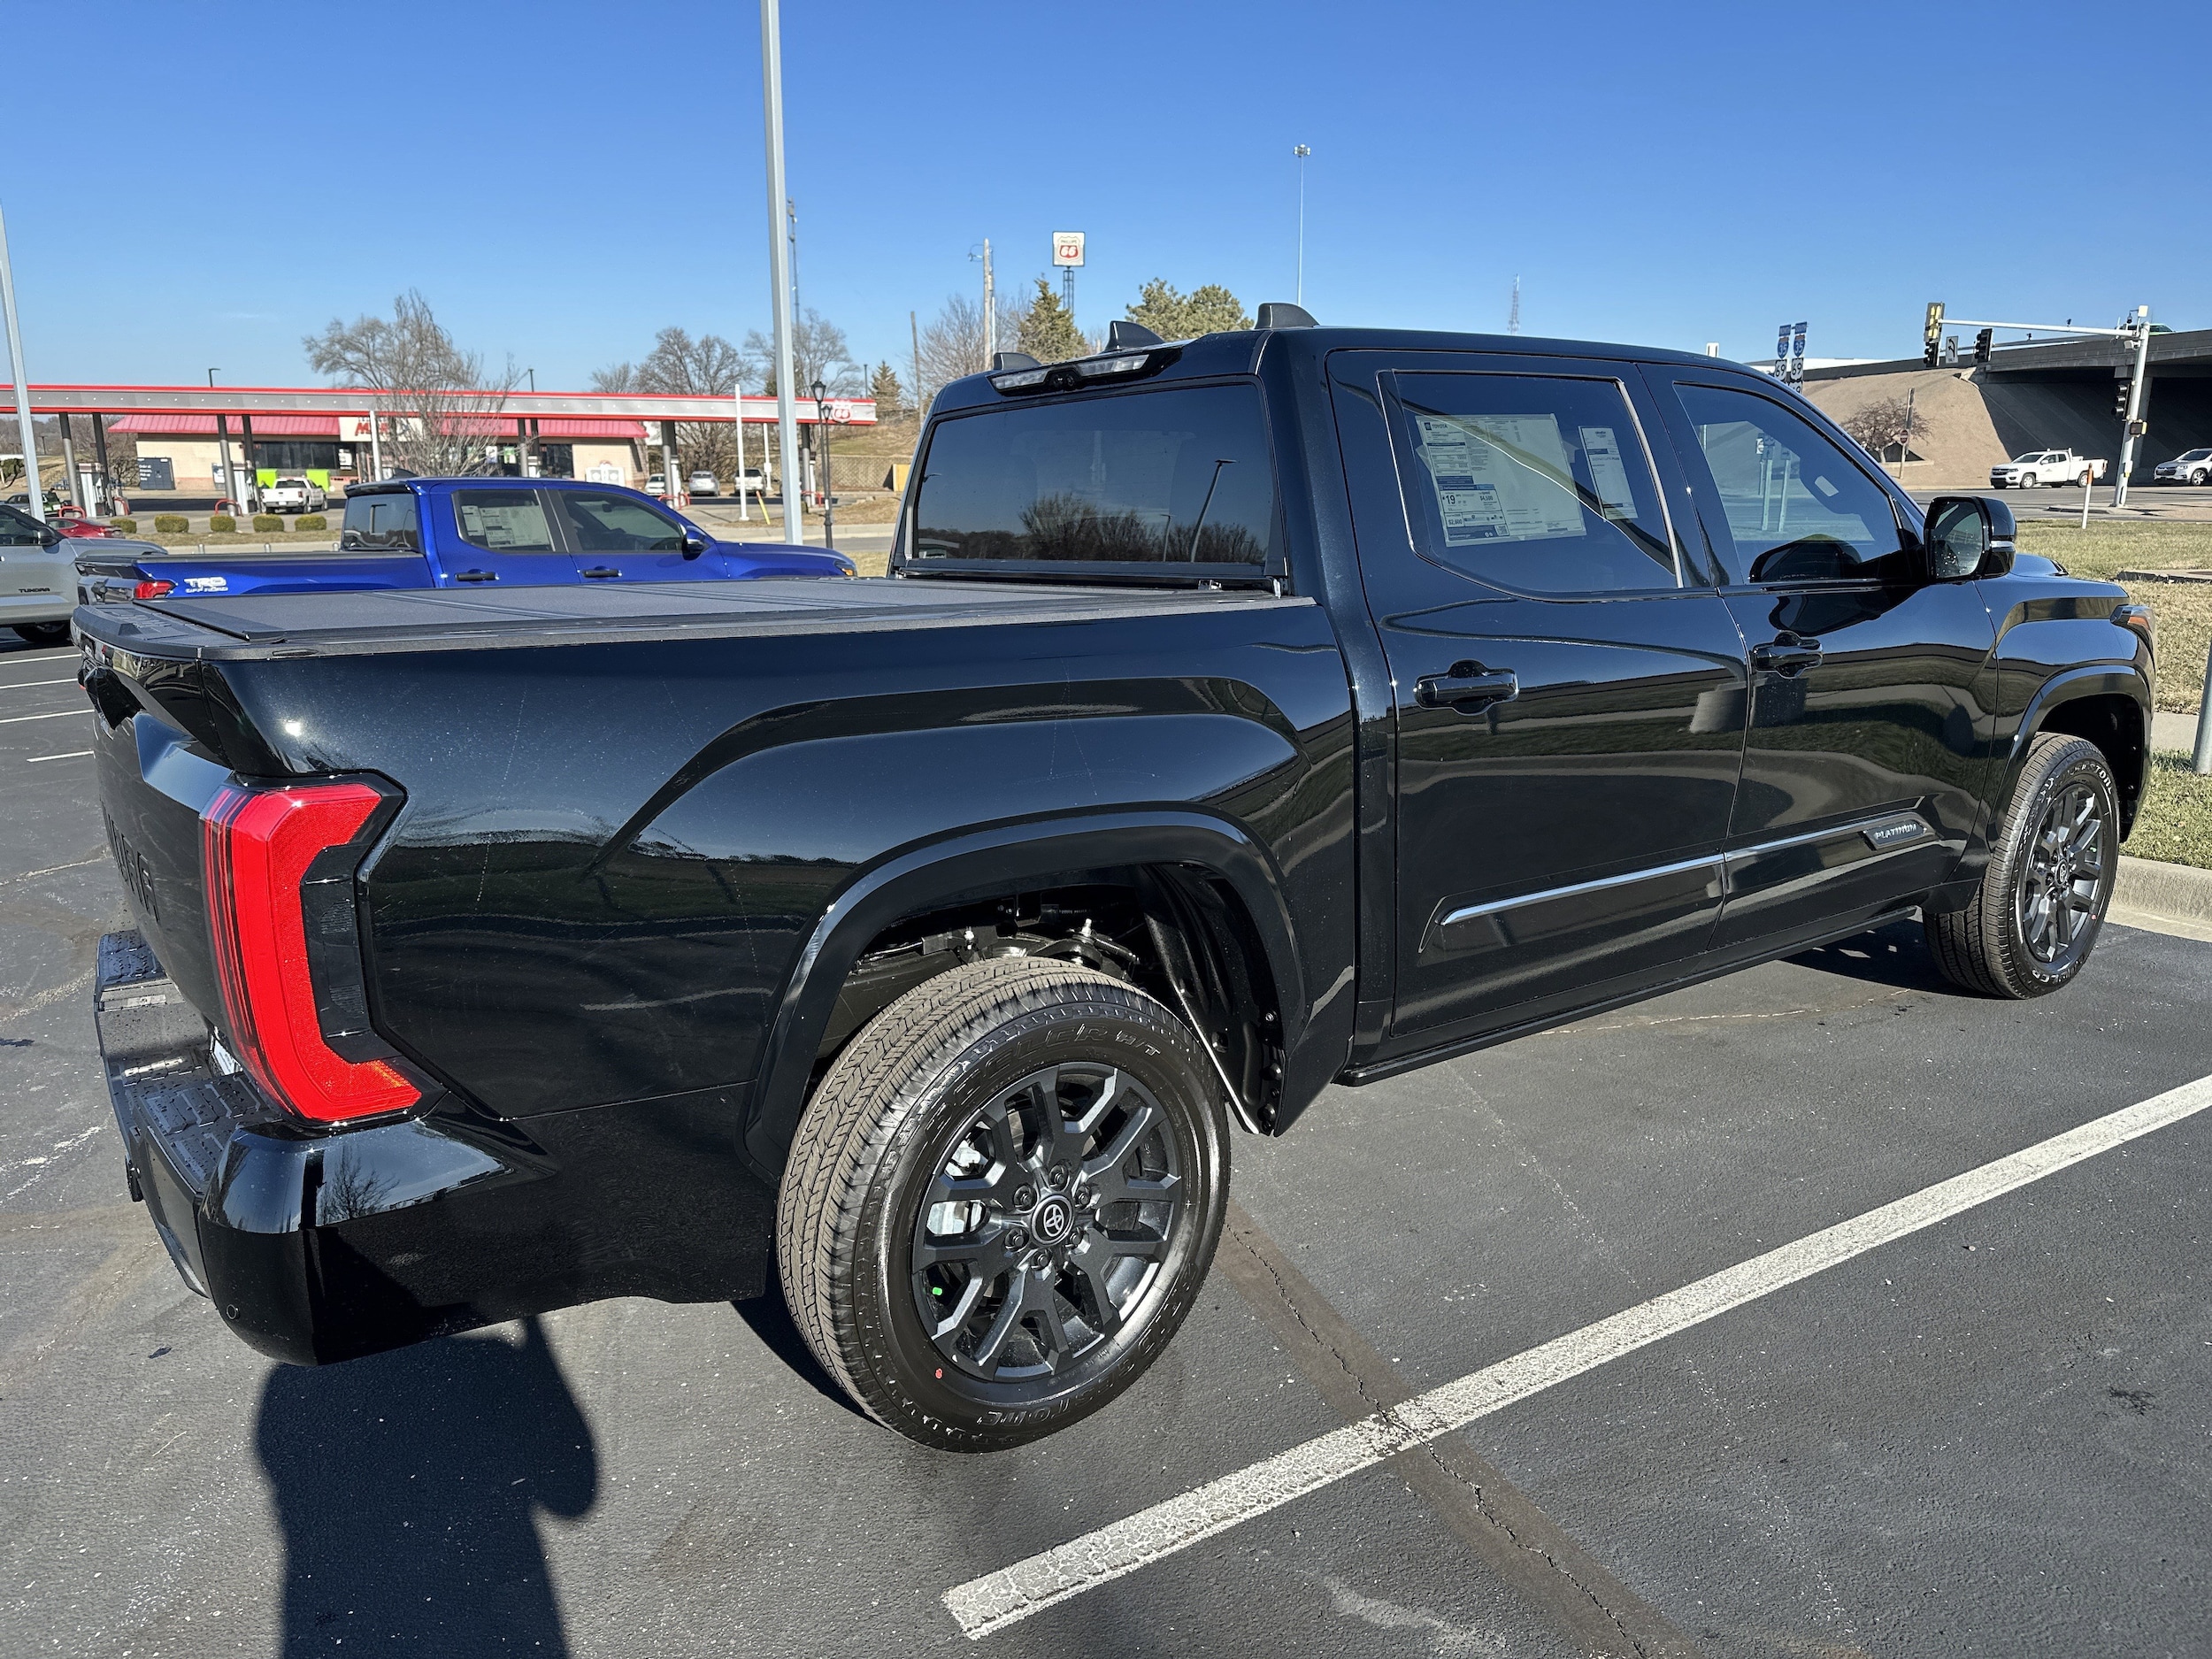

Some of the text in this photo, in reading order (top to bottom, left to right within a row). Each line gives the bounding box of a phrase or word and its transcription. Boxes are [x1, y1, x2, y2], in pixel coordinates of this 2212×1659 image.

[1061, 246, 1077, 257] 66
[1779, 344, 1787, 355] 35
[1795, 342, 1802, 353] 35
[1776, 365, 1786, 377] 69
[1792, 363, 1801, 375] 69
[1446, 495, 1455, 504] 19
[183, 576, 227, 588] TRD
[1875, 824, 1916, 840] PLATINUM
[1115, 1029, 1161, 1057] H/T
